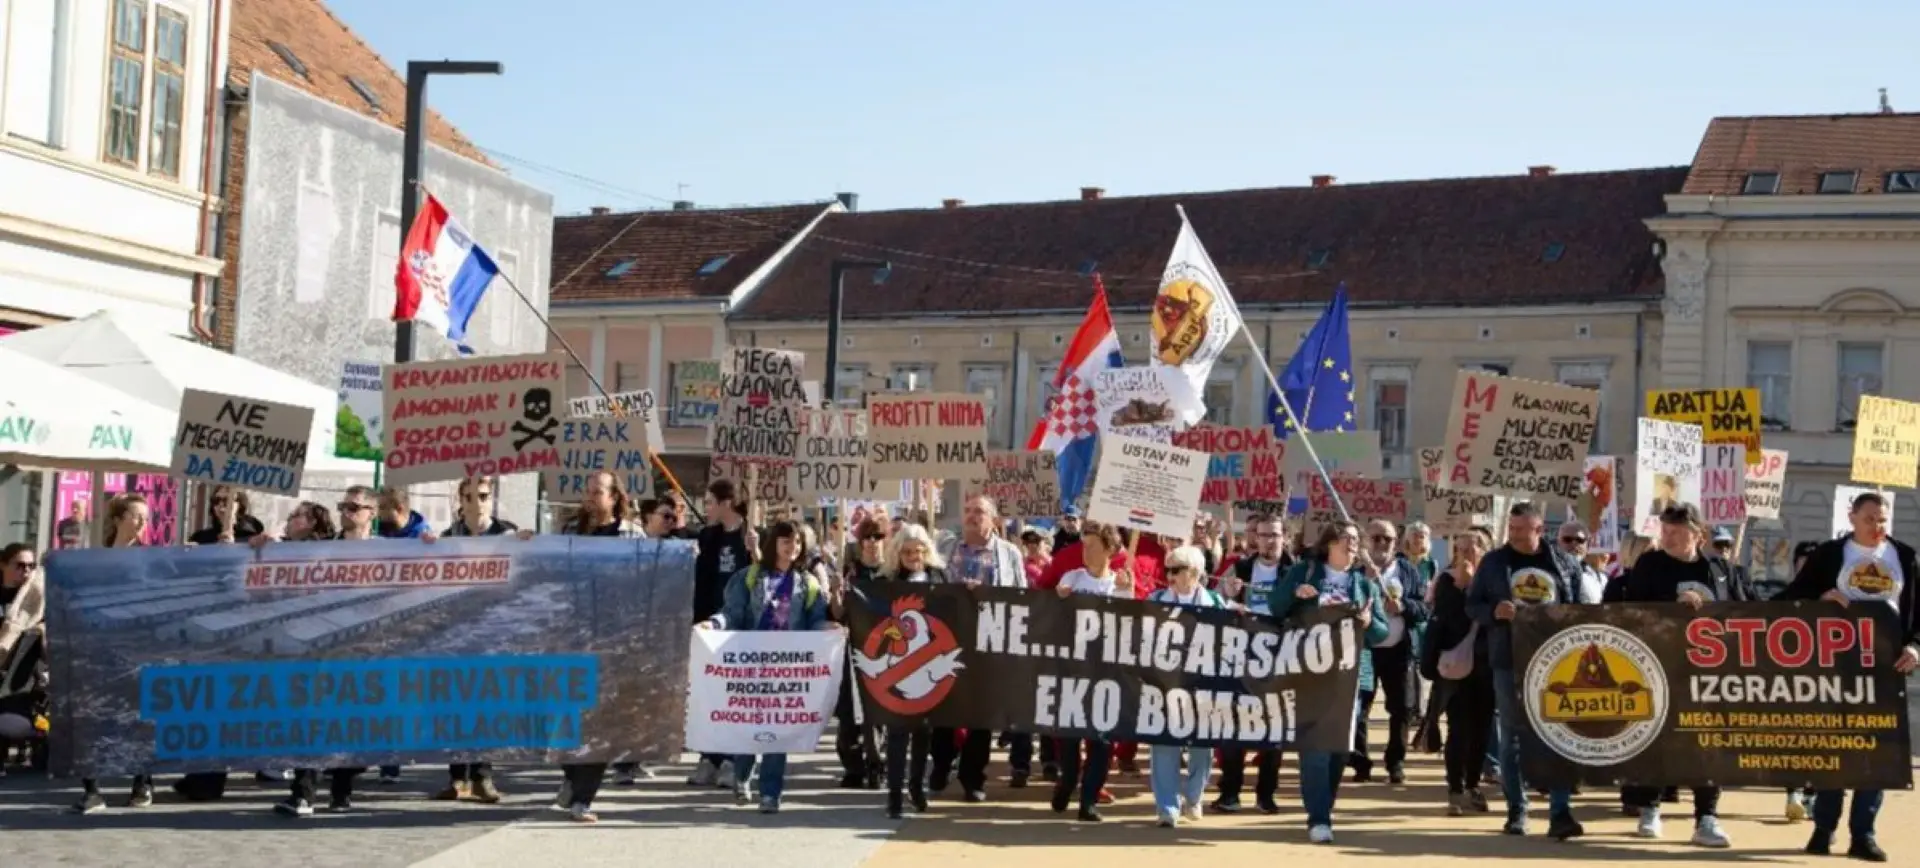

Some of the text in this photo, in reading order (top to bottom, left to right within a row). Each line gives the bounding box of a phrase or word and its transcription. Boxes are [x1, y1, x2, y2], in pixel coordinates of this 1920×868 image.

[733, 350, 793, 375] MEGA
[720, 372, 808, 404] KLAONICA
[216, 400, 270, 429] NE
[392, 392, 517, 421] AMONIJAK I
[573, 400, 591, 416] MI
[872, 401, 985, 427] PROFIT NJIMA
[1512, 392, 1591, 419] KLAONICA
[1654, 389, 1746, 415] APATIJA
[736, 405, 793, 429] MEGA
[1710, 414, 1753, 433] DOM
[394, 420, 506, 446] FOSFOR U
[1502, 417, 1593, 443] MUČENJE
[180, 421, 307, 468] MEGAFARMAMA
[806, 437, 868, 458] ODLUČN
[872, 442, 929, 464] SMRAD
[937, 441, 987, 463] NAMA
[1122, 443, 1168, 462] USTAV
[1169, 453, 1191, 467] RH
[184, 454, 295, 491] DA ŽIVOTU
[464, 448, 561, 477] VODAMA
[614, 450, 646, 470] NA
[1252, 453, 1277, 477] NA
[1499, 458, 1536, 475] CIJA
[795, 462, 877, 492] PROTI
[246, 559, 509, 586] NE PILIĆARSKOJ EKO BOMBI!
[1685, 617, 1876, 668] STOP!
[723, 651, 815, 664] IZ OGROMNE
[704, 664, 832, 679] PATNJE ŽIVOTINJA
[151, 667, 588, 712] SVI ZA SPAS HRVATSKE
[726, 681, 810, 694] PROIZLAZI I
[1690, 675, 1876, 703] IZGRADNJI
[728, 696, 805, 709] PATNJA ZA
[1034, 674, 1297, 743] EKO BOMBI!
[1558, 692, 1636, 715] Apatija
[710, 709, 764, 725] OKOLIŠ
[1679, 712, 1898, 729] MEGA PERADARSKIH FARMI
[163, 710, 574, 751] OD MEGAFARMI I KLAONICA
[1698, 734, 1877, 749] U SJEVEROZAPADNOJ
[1738, 755, 1841, 770] HRVATSKOJI
